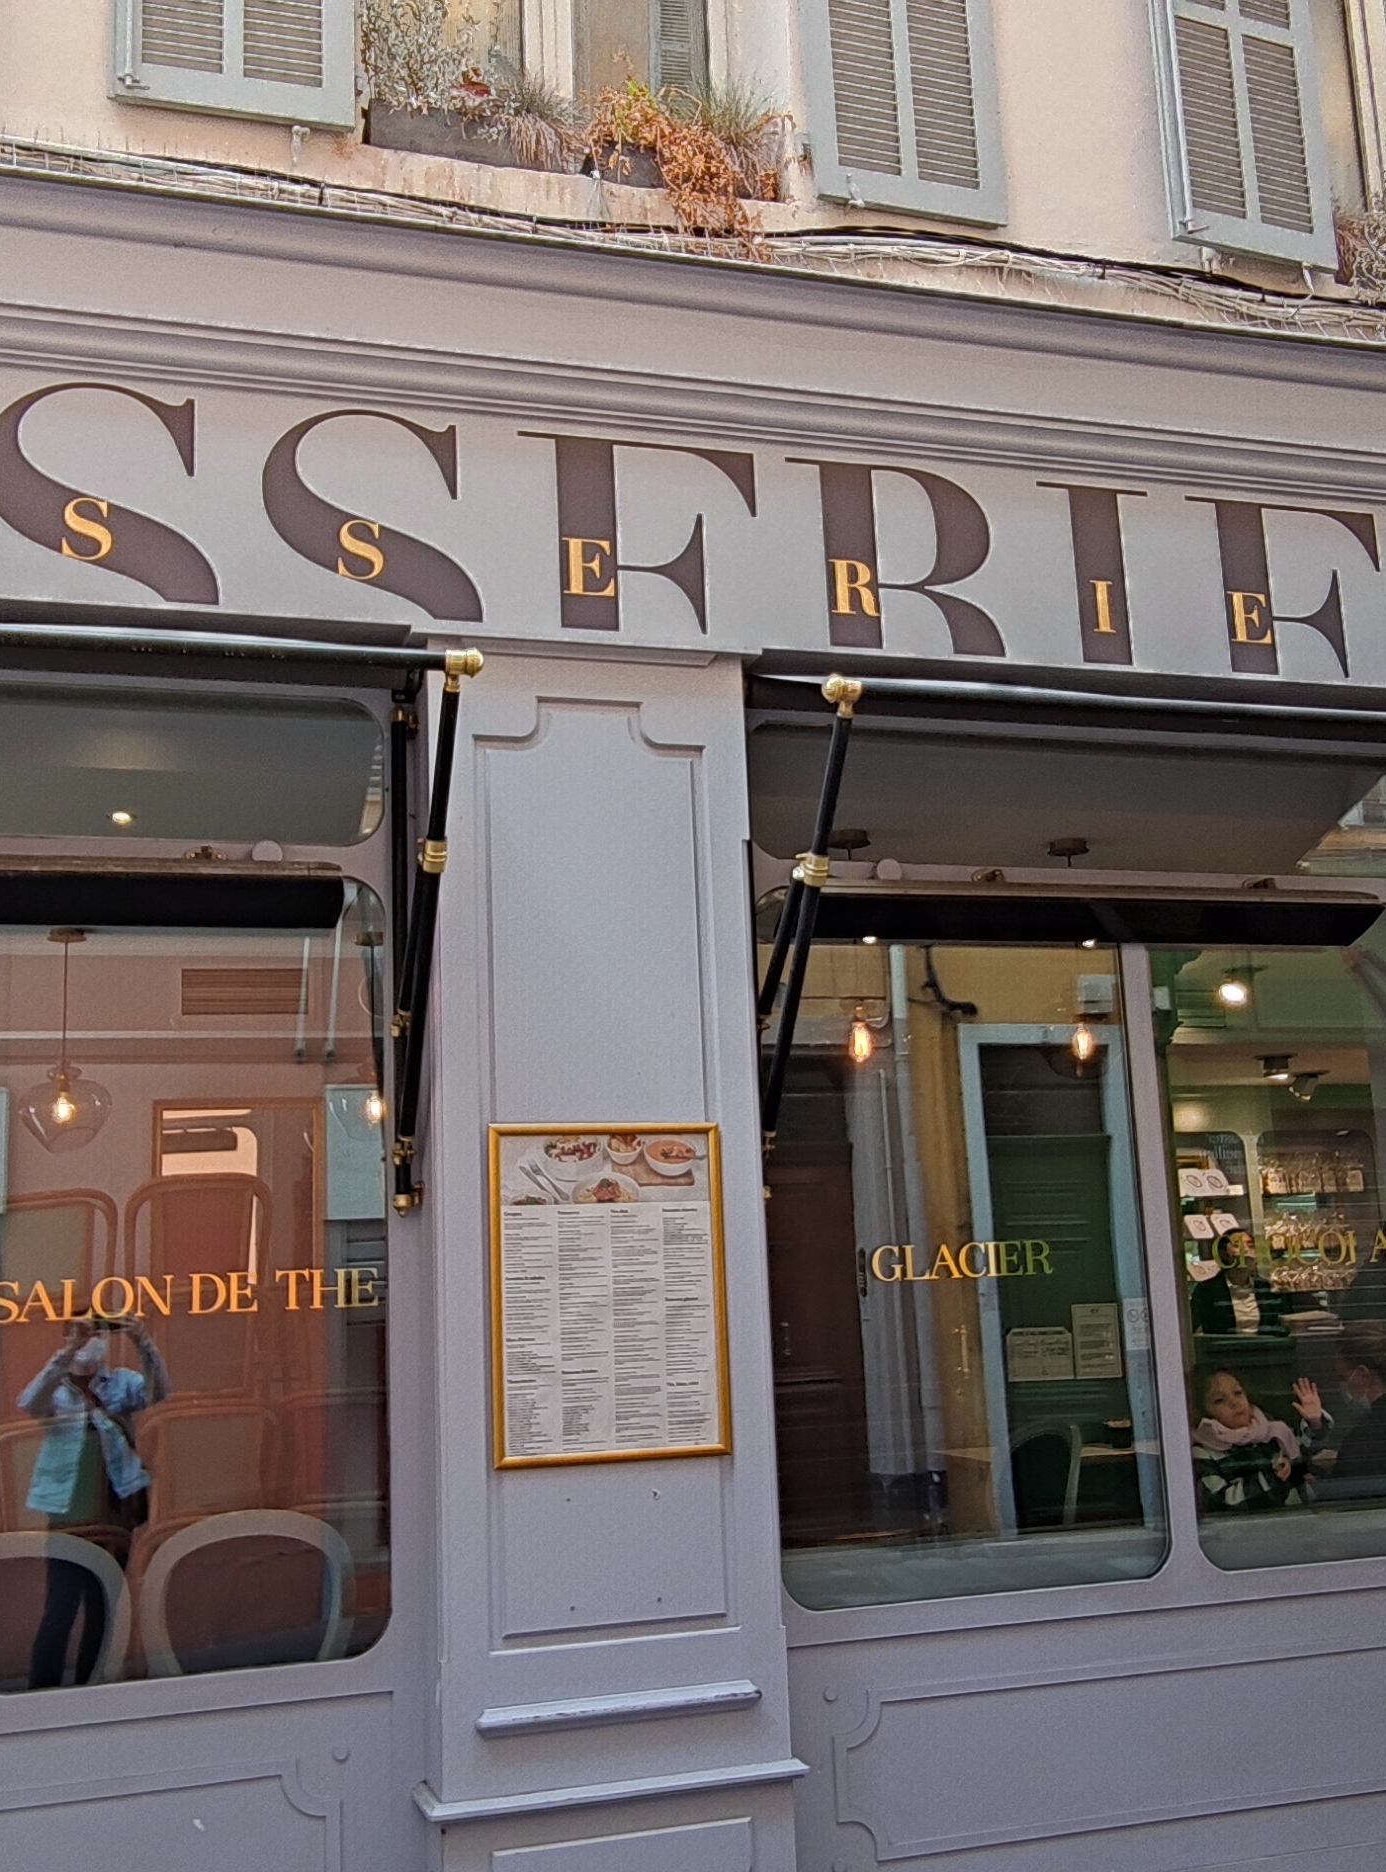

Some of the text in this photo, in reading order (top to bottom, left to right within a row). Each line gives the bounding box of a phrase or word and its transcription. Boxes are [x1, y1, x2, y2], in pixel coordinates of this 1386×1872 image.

[871, 1239, 1053, 1281] GLACIER
[189, 1271, 258, 1314] DE
[275, 1267, 379, 1311] THE
